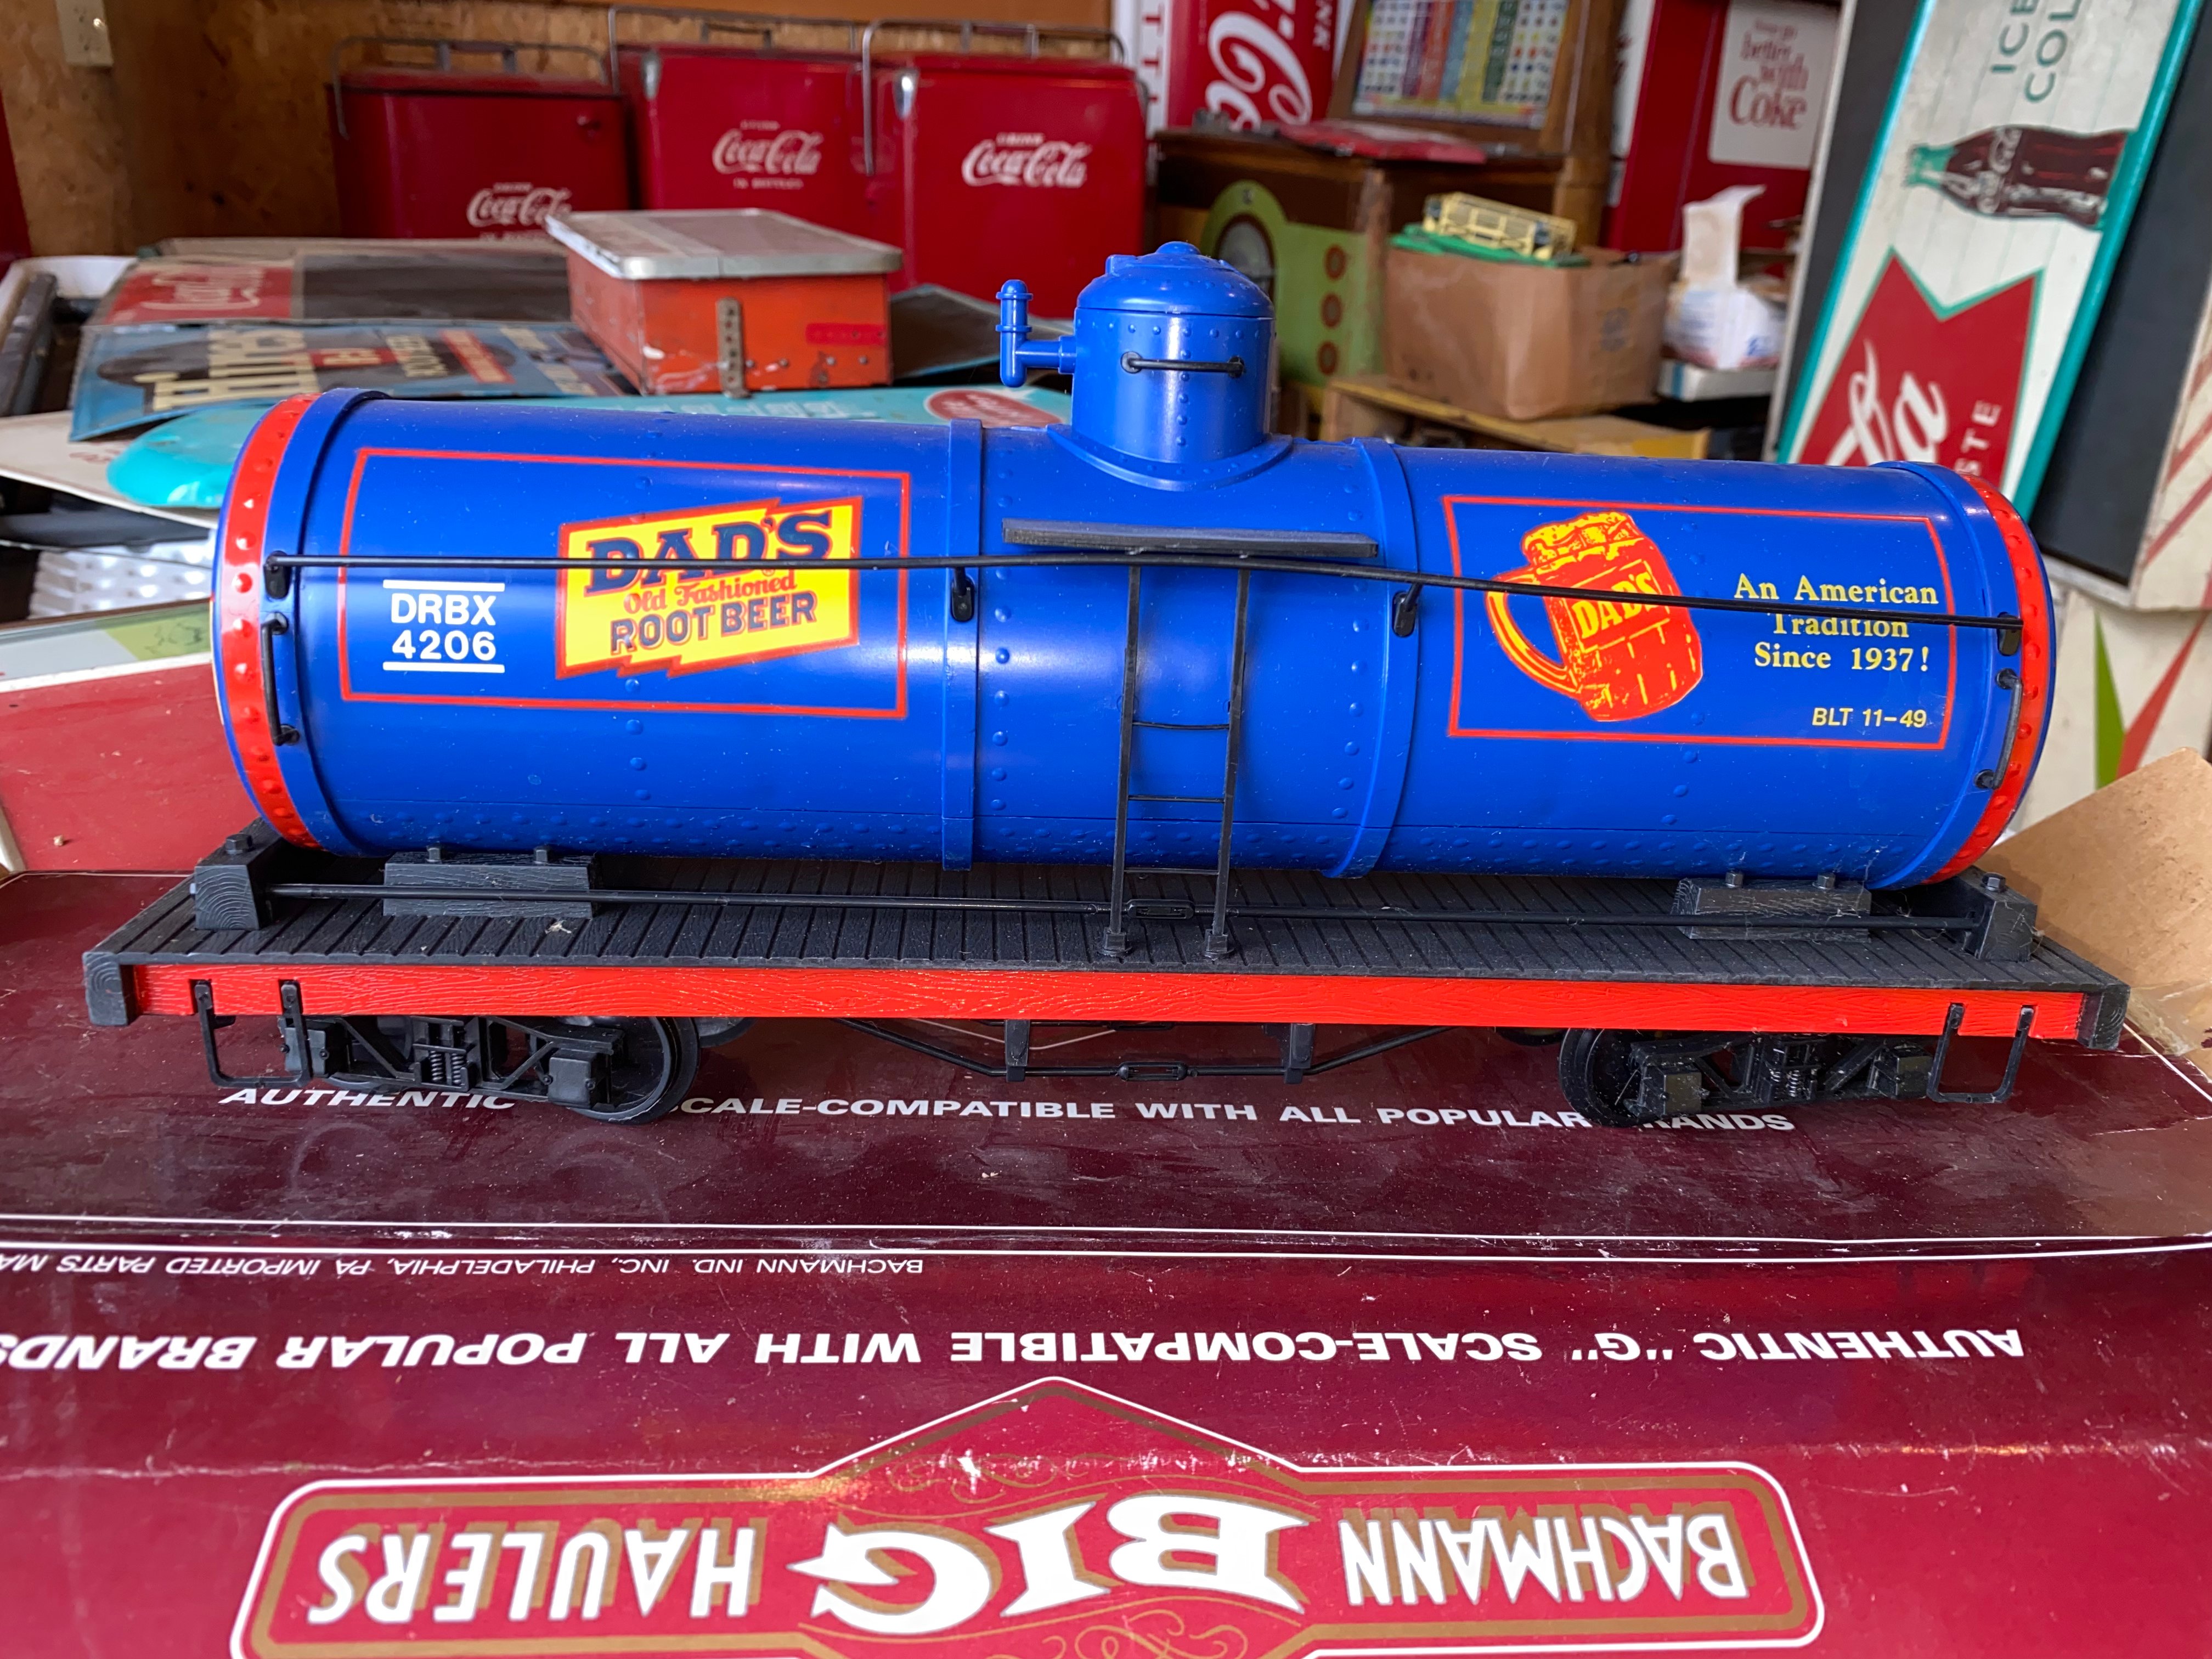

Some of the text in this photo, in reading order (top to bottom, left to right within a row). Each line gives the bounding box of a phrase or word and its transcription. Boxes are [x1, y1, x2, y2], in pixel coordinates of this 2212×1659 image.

[2024, 0, 2082, 103] COL
[1730, 75, 1807, 130] Coke
[712, 128, 823, 174] Coca-Cola
[962, 139, 1092, 188] Coca-Cola
[584, 509, 833, 597] DAD'S
[623, 569, 798, 614] Old Fashioned
[1734, 573, 1939, 605] An American
[391, 592, 496, 626] DRBX
[610, 590, 819, 656] ROOT BEER
[1767, 611, 1909, 638] Tradition
[392, 629, 496, 661] 4206
[1754, 641, 1930, 672] Since 1937!
[1812, 707, 1927, 728] BLT 11-49
[218, 1088, 516, 1109] AUTHENTIC
[670, 1098, 1795, 1131] CALE-COMPATIBLE WITH ALL POPULAR ANDS
[56, 1255, 156, 1273] PARTS
[166, 1257, 321, 1274] IMPORTED
[335, 1259, 372, 1276] PA
[387, 1258, 595, 1274] PHILADELPHIA,
[692, 1258, 742, 1274] IND.
[754, 1259, 924, 1274] BACHMANN
[276, 1332, 588, 1369] POPULAR
[615, 1332, 731, 1364] ALL
[754, 1332, 922, 1364] WITH
[950, 1331, 1541, 1362] SCALE-COMPATIBLE
[1692, 1328, 2025, 1360] AUTHENTIC
[307, 1494, 1749, 1635] BACHMANN BIG HAULERS
